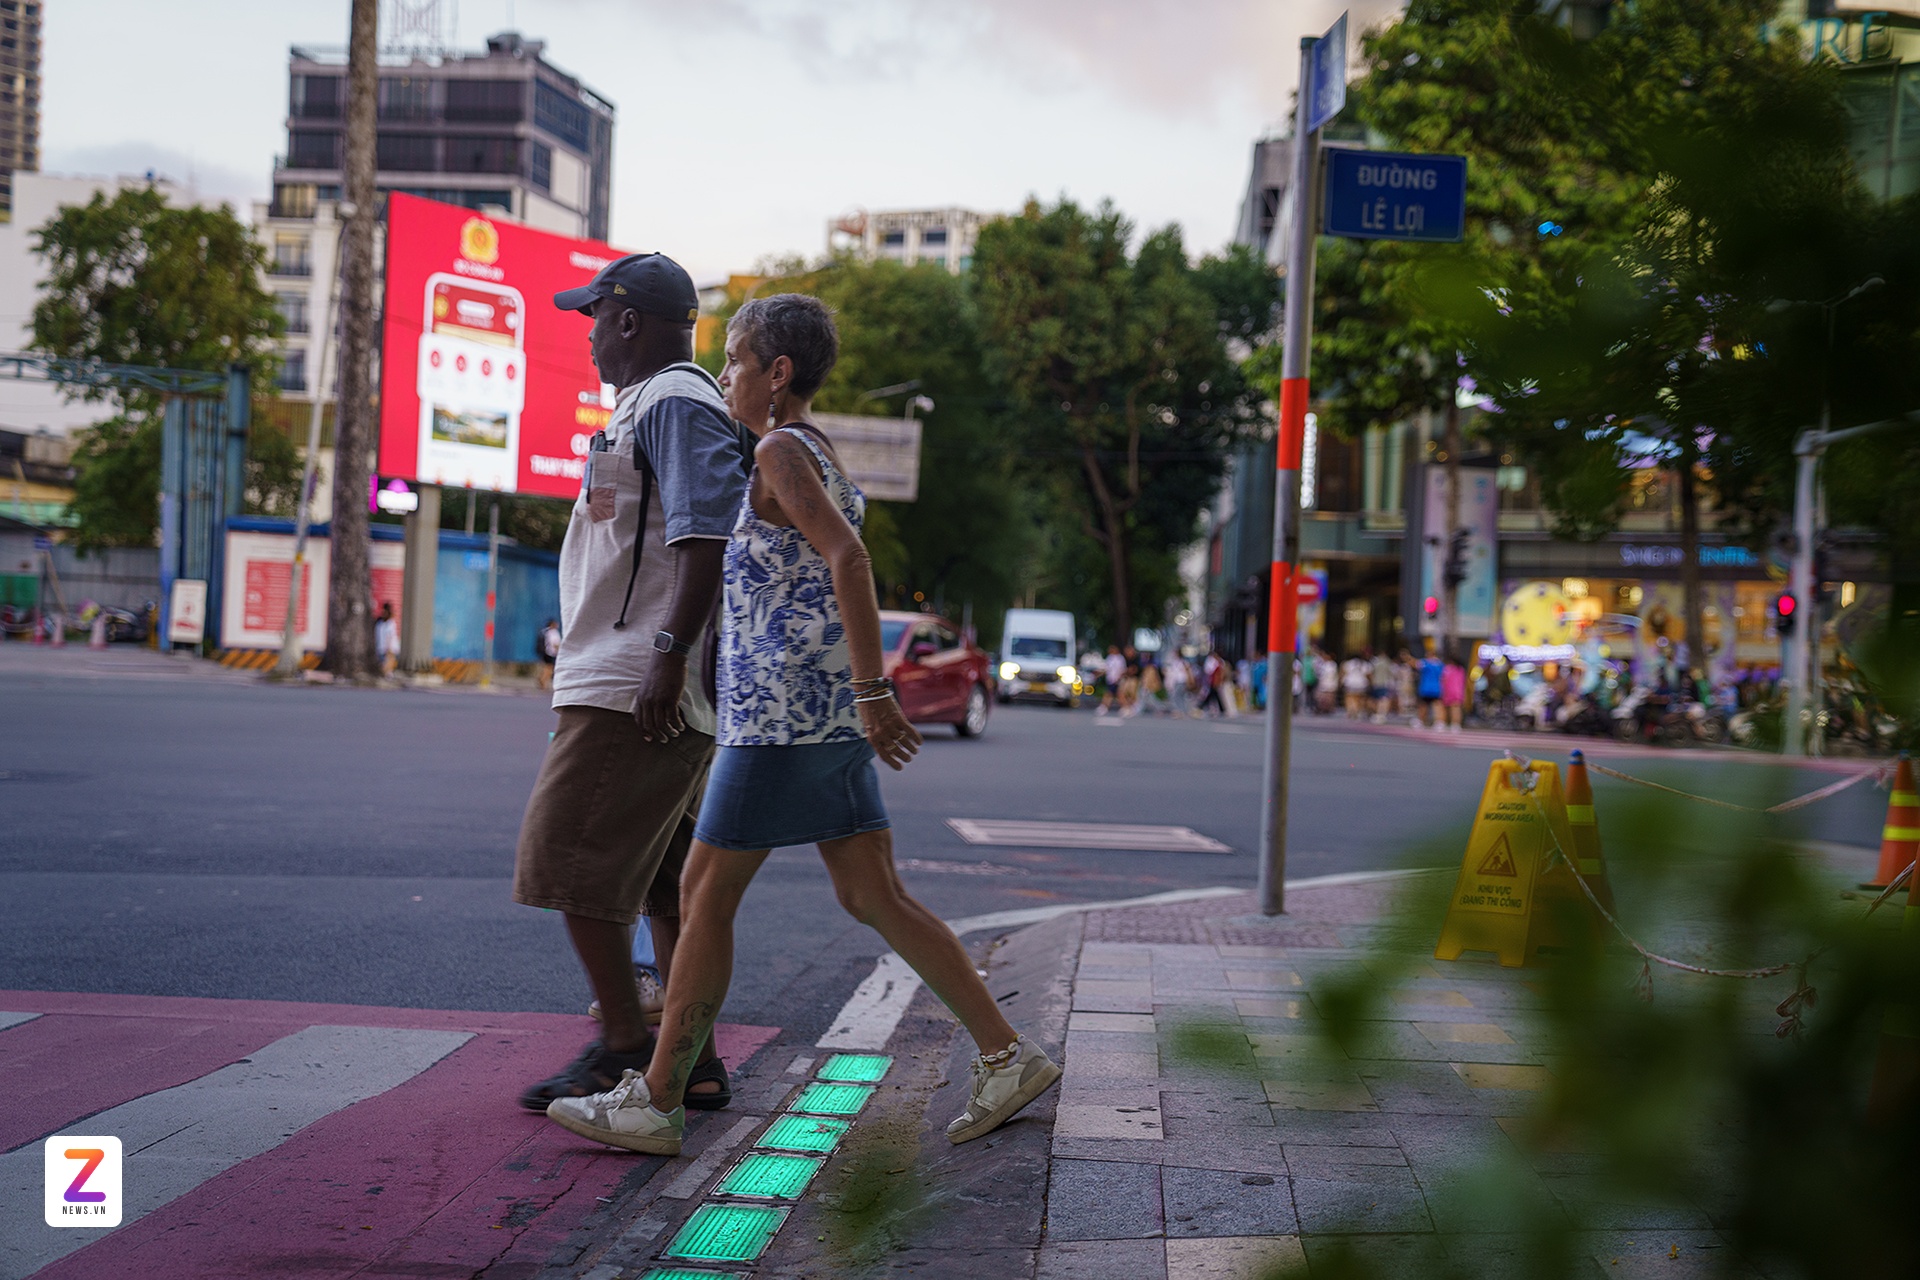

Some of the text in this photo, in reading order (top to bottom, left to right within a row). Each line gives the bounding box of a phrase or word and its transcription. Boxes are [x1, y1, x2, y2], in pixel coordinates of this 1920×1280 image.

[1357, 162, 1437, 190] ĐƯỜNG
[1361, 196, 1425, 237] LÊ LỢI
[1497, 803, 1527, 812] CAUTION
[1485, 813, 1534, 822] WORKING AREA
[1478, 884, 1493, 893] KHU
[1487, 897, 1499, 906] THI
[1500, 897, 1521, 907] CÔNG
